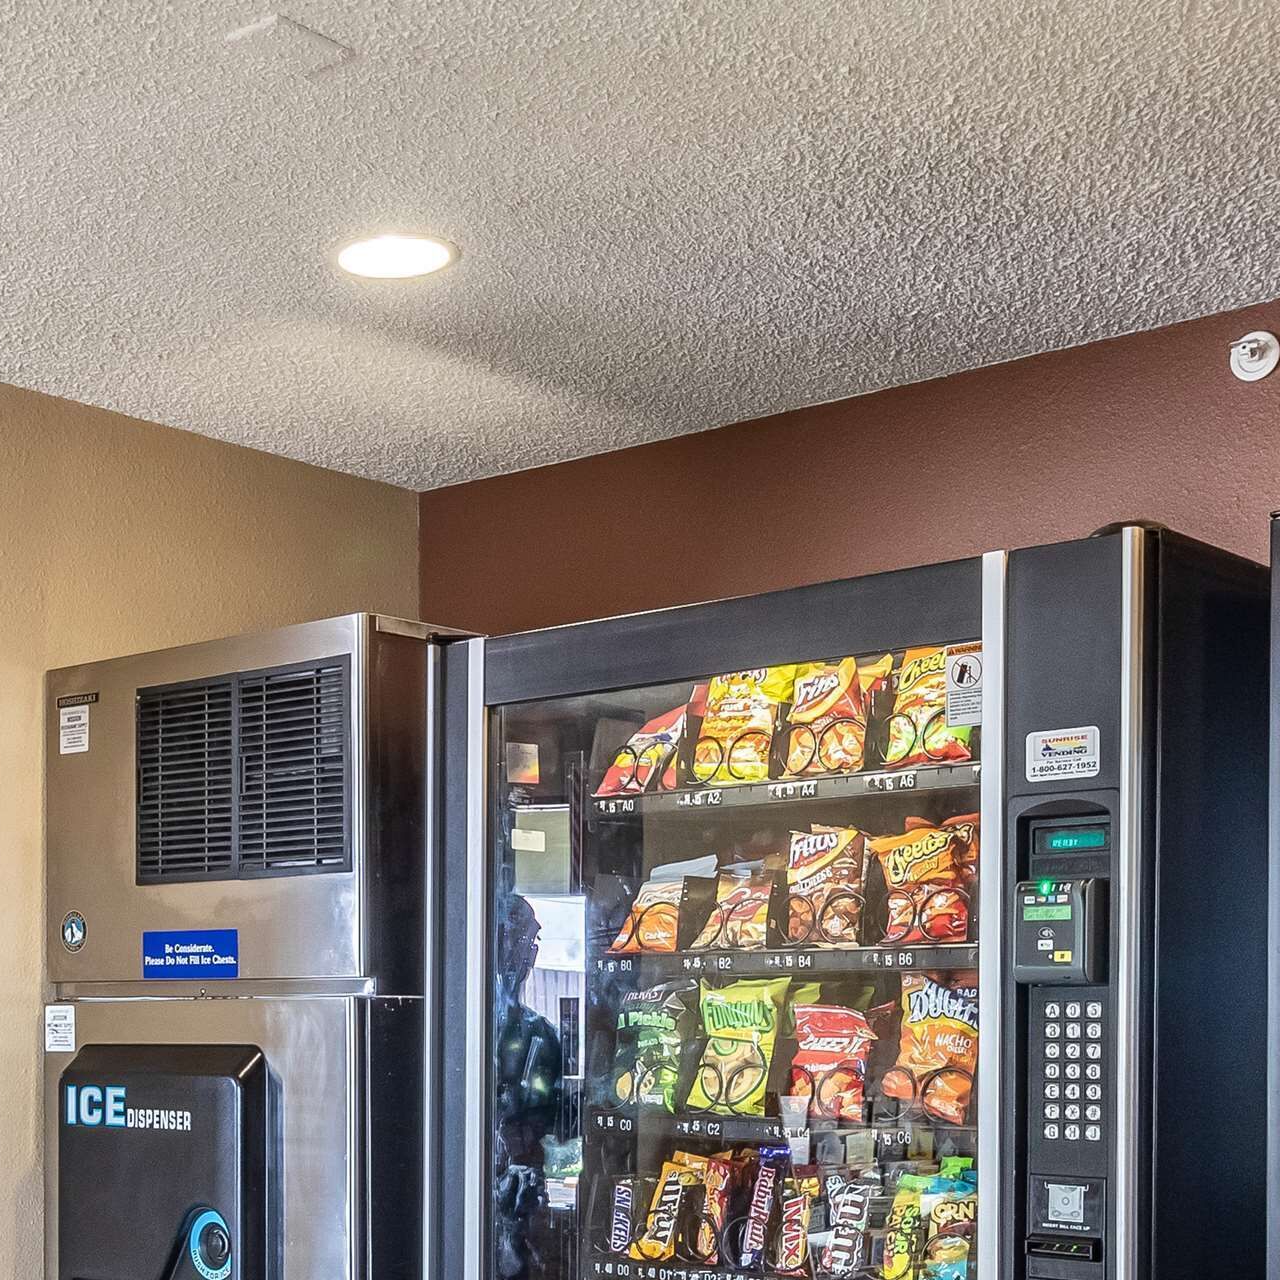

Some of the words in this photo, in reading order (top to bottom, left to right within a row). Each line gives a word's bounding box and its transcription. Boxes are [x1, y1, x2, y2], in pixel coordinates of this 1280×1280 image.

[1041, 749, 1087, 757] VENDING
[1032, 761, 1097, 773] 1-800-627-1952
[900, 775, 914, 787] A6
[801, 783, 815, 796] A4
[165, 944, 173, 953] Be
[145, 956, 164, 965] Please
[166, 956, 175, 965] Do
[176, 956, 188, 965] Not
[189, 955, 200, 965] Fill
[201, 955, 211, 965] Ice
[65, 1085, 126, 1127] ICE
[126, 1108, 192, 1131] DISPENSER
[707, 1123, 720, 1135] C2
[897, 1131, 911, 1144] C6
